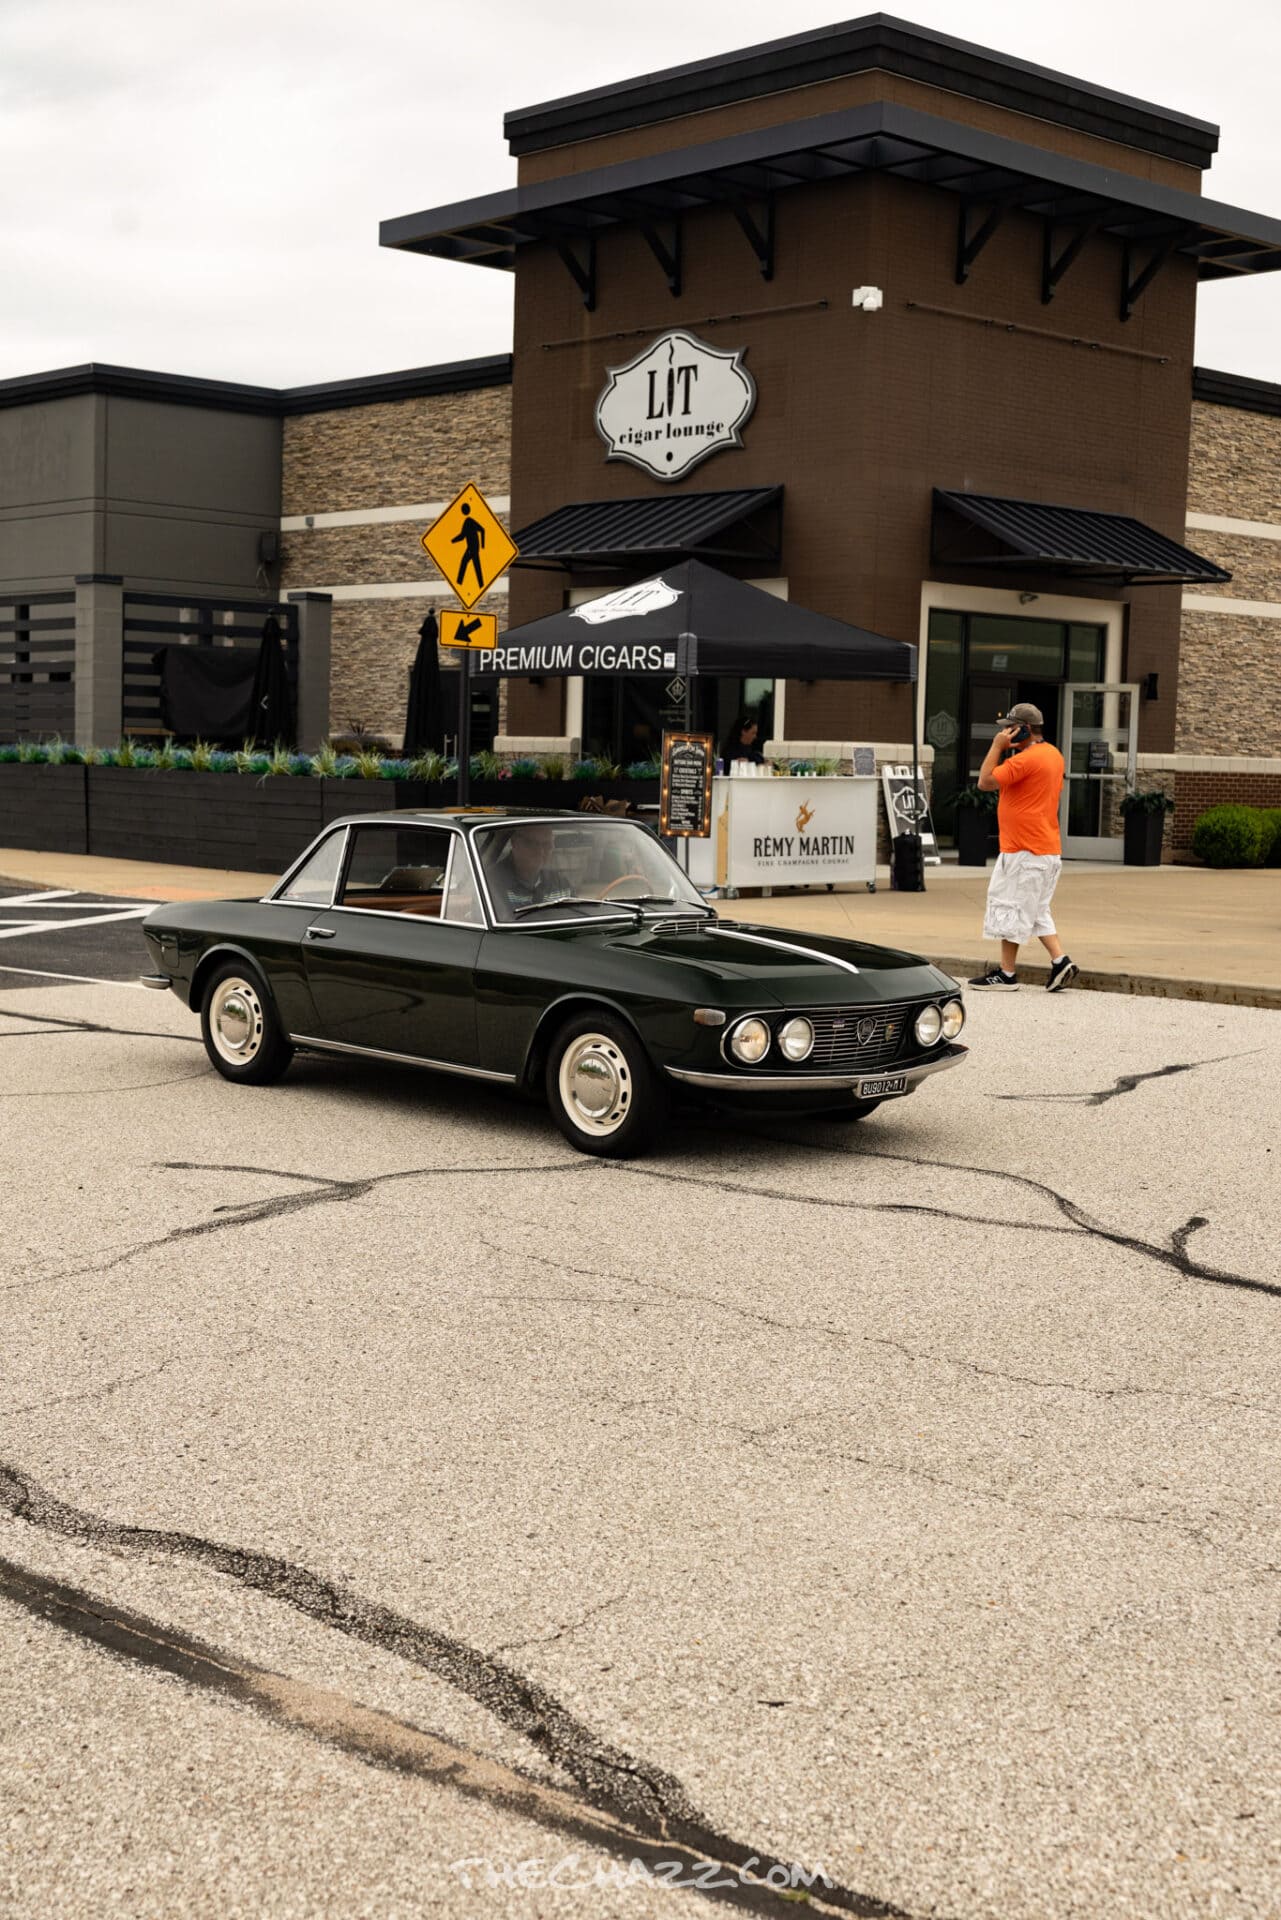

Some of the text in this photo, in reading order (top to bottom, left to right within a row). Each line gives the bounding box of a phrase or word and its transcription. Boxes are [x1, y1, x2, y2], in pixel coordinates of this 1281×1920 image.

[646, 364, 698, 420] LIT
[619, 421, 724, 445] cigar lounge
[479, 644, 574, 671] PREMIUM
[578, 645, 662, 671] CIGARS
[753, 835, 855, 858] RÉMY MARTIN
